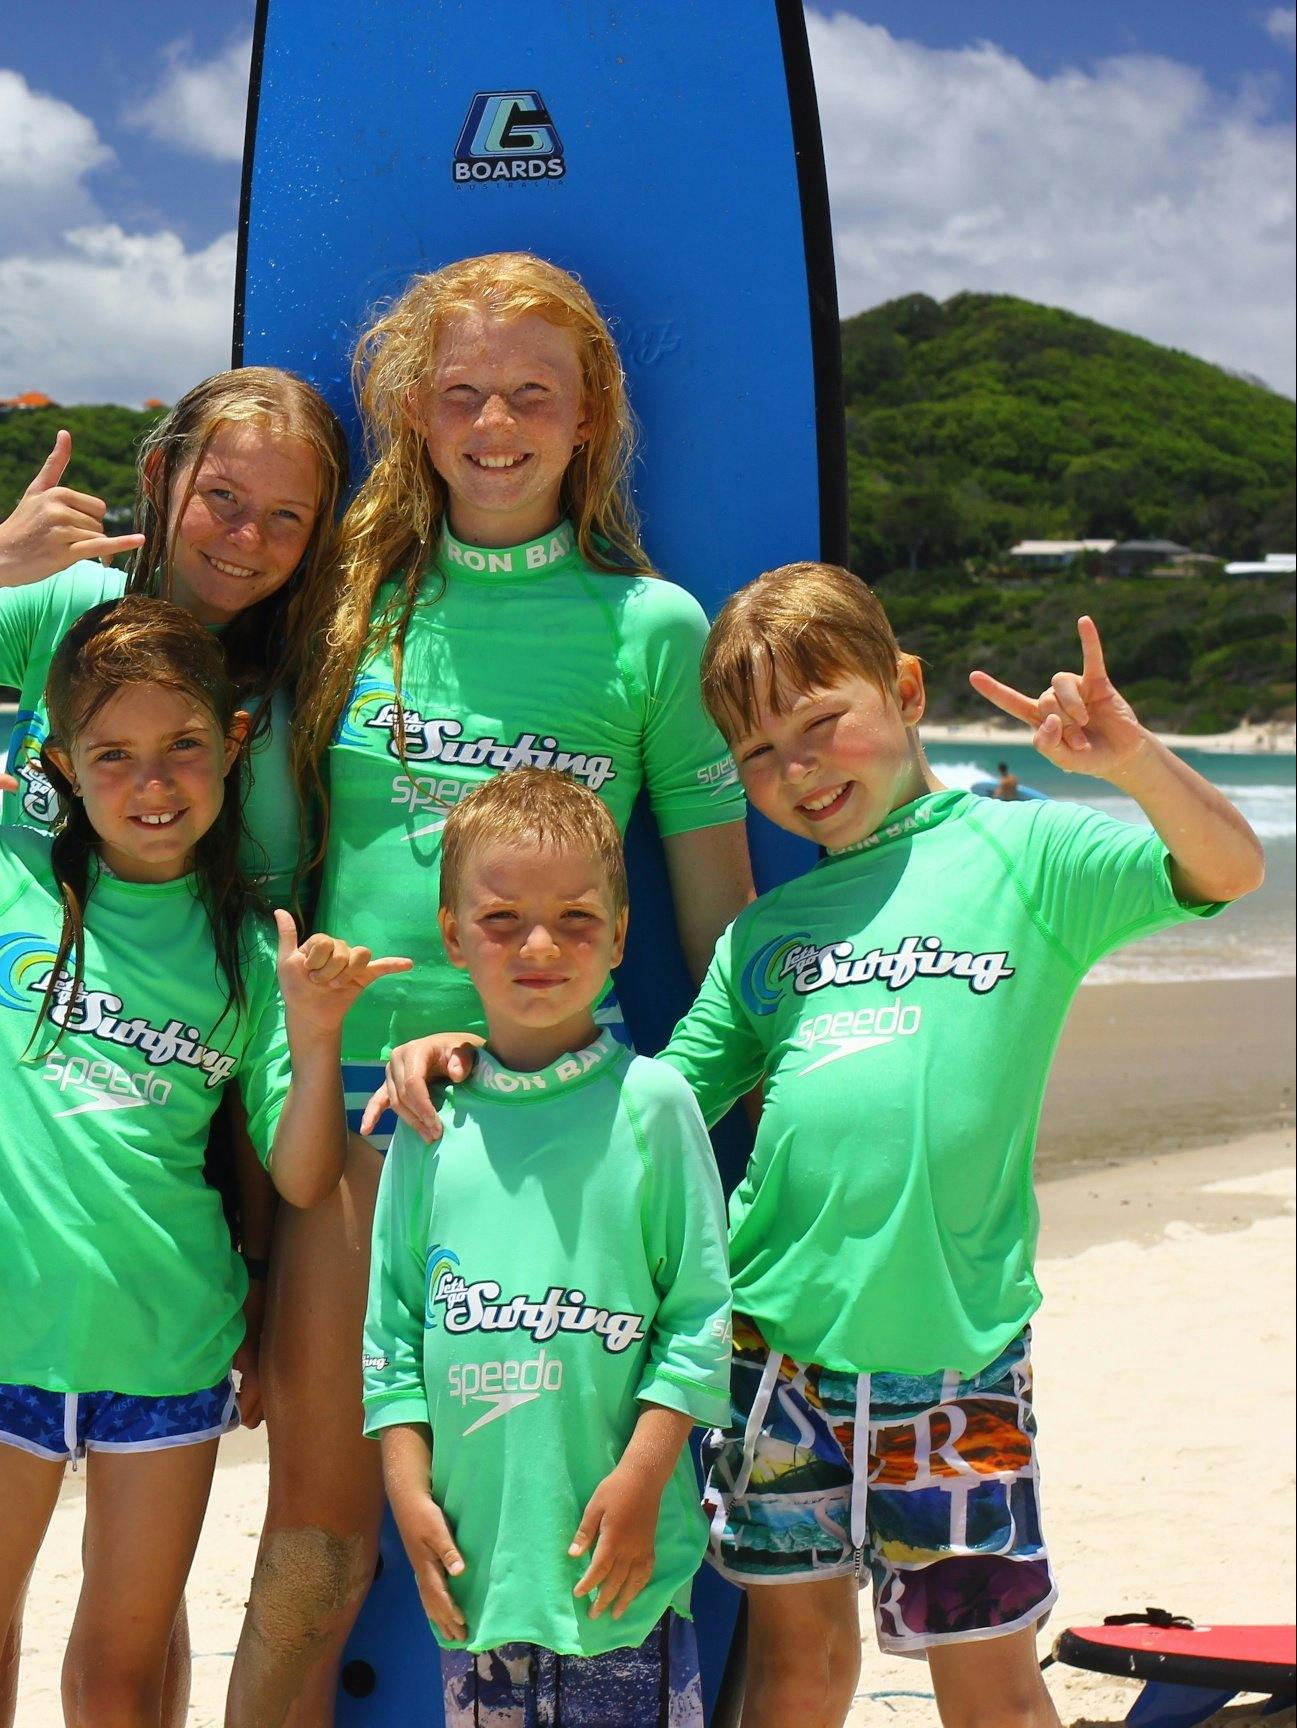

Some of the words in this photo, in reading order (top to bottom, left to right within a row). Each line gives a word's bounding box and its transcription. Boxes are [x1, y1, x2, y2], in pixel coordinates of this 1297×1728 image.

[455, 158, 564, 180] BOARDS
[446, 541, 513, 573] RON
[388, 718, 616, 792] Surfing
[390, 775, 476, 813] spee
[885, 804, 933, 839] BAY
[794, 937, 1016, 993] Surfing
[50, 992, 238, 1087] Surfing
[796, 996, 922, 1050] speedo
[42, 1052, 173, 1107] speedo
[445, 1281, 645, 1352] Surfing
[447, 1348, 563, 1406] speedo
